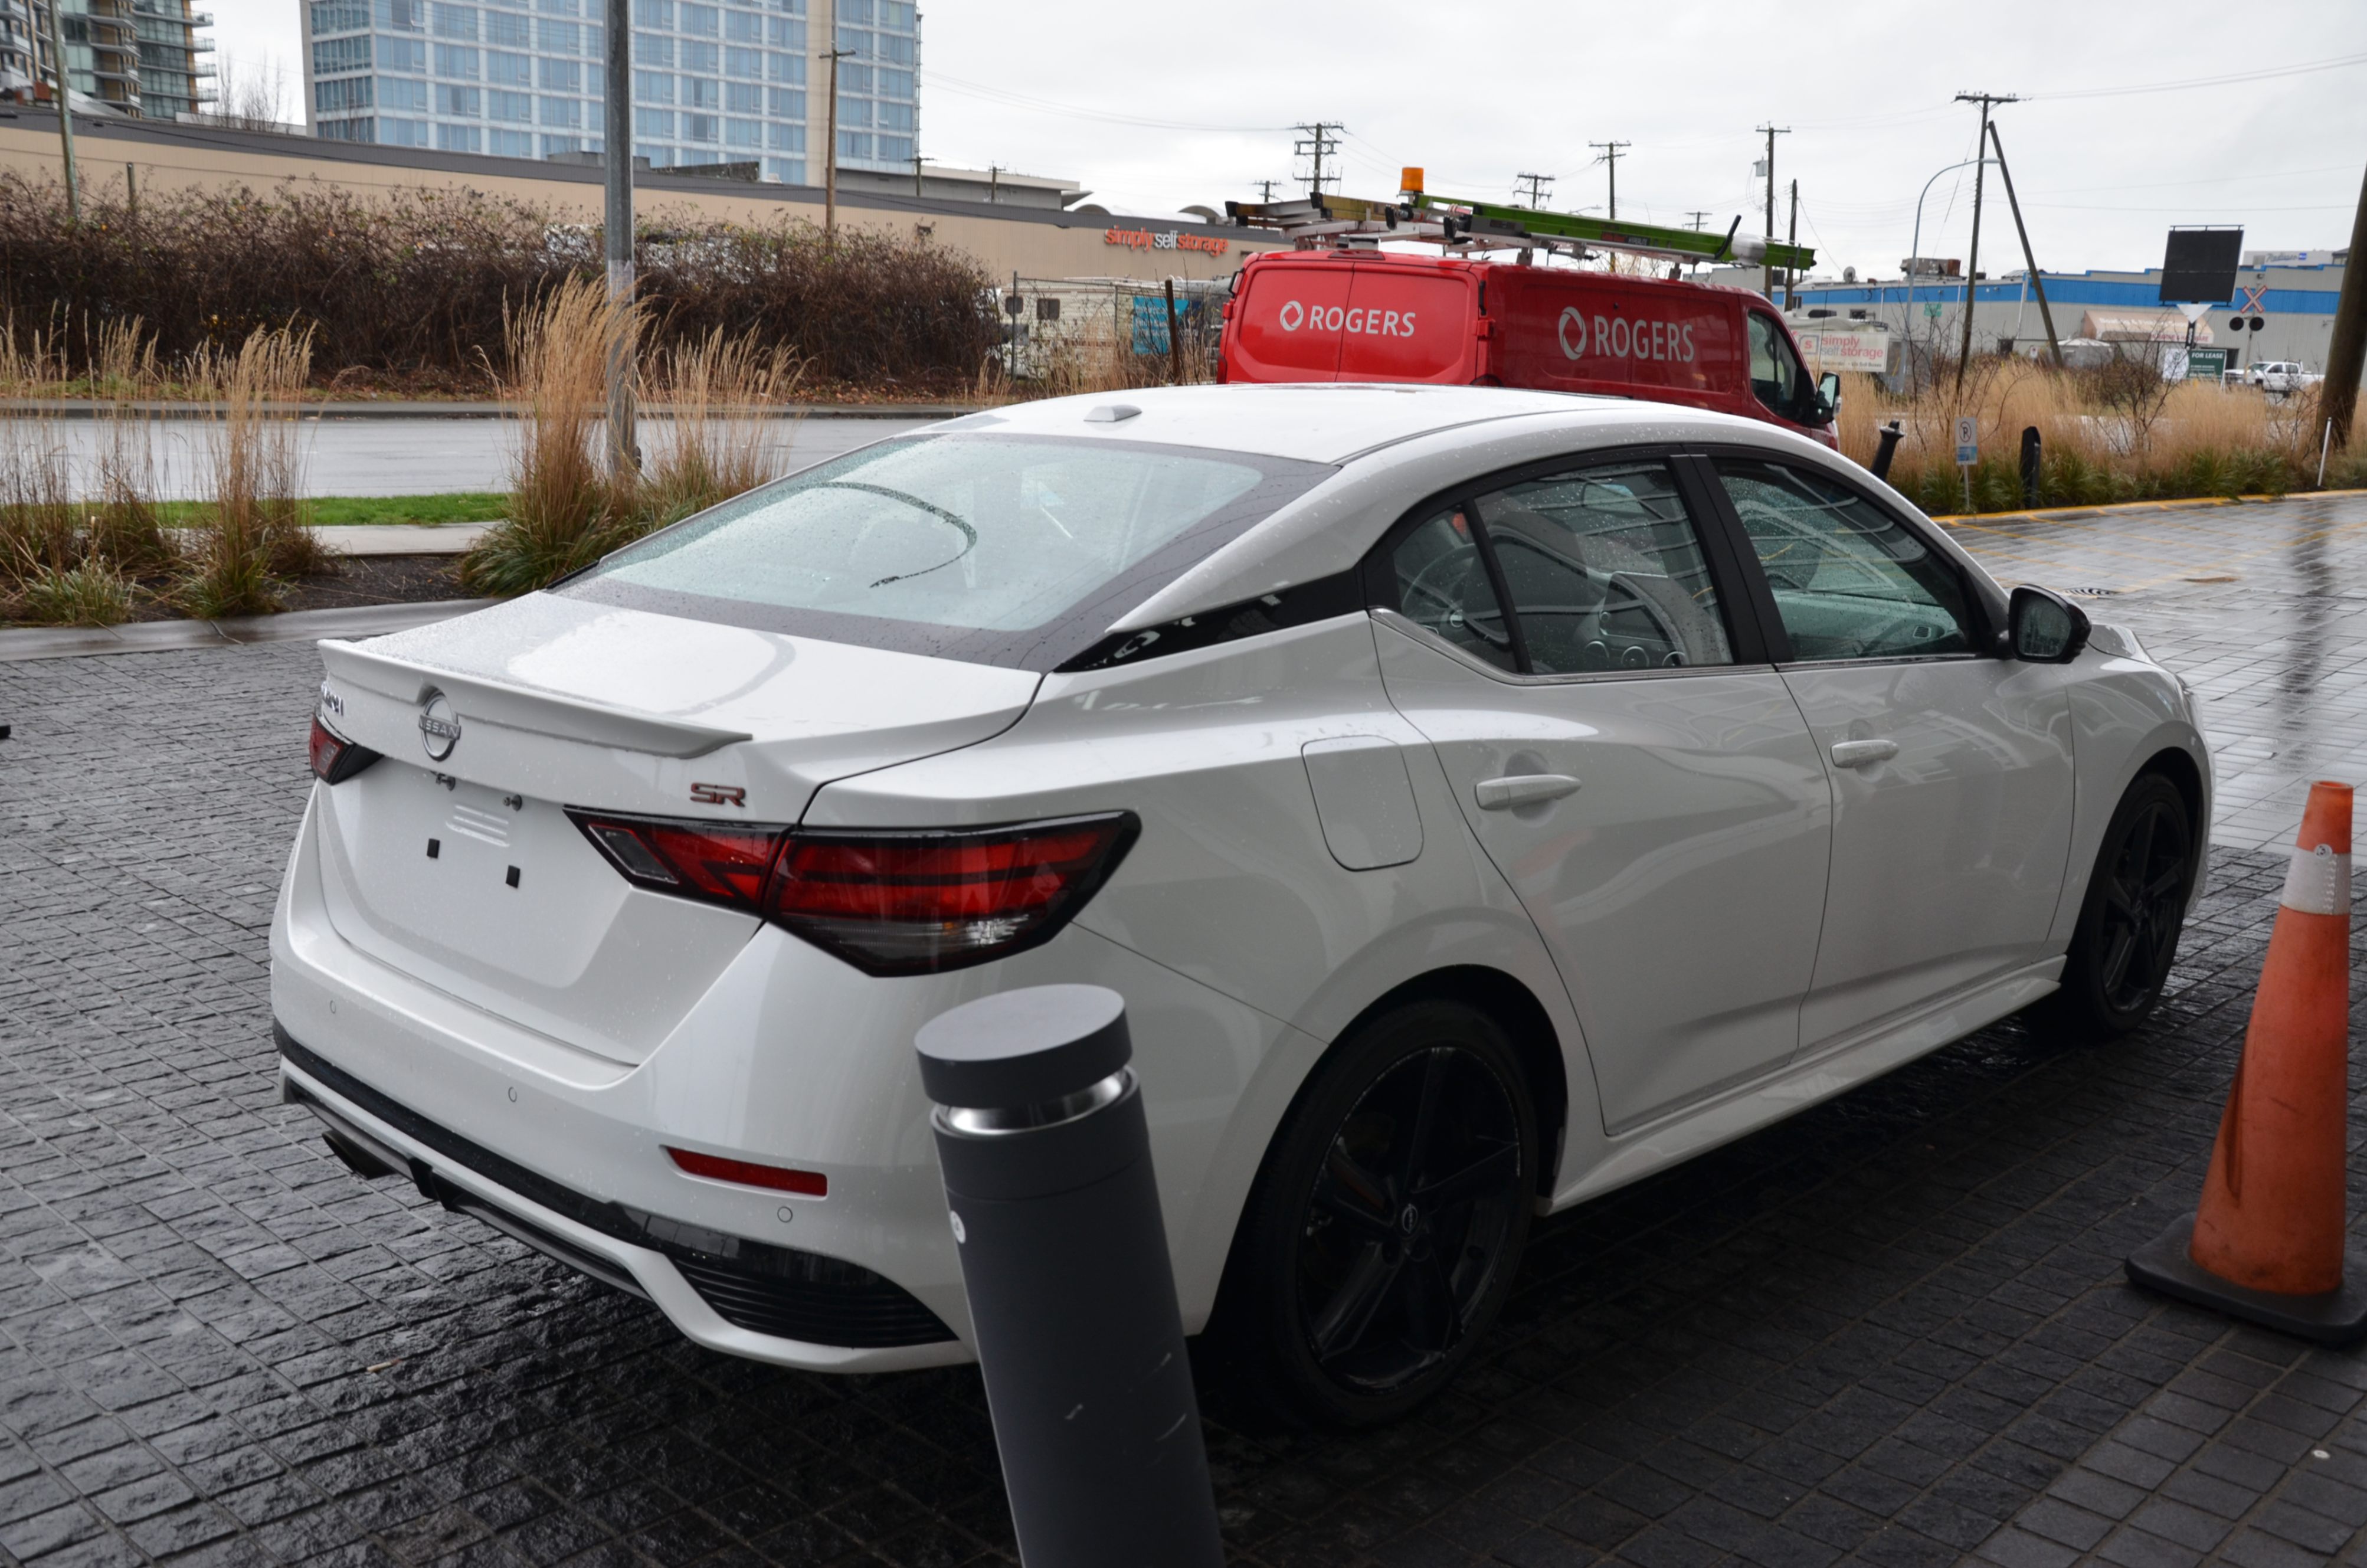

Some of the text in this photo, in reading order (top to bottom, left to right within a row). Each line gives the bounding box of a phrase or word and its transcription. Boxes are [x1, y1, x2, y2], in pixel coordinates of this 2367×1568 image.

[1309, 305, 1416, 337] ROGERS
[1594, 315, 1694, 362] ROGERS
[1822, 335, 1860, 348] simply
[1821, 345, 1883, 360] self storage
[690, 783, 746, 807] SR
